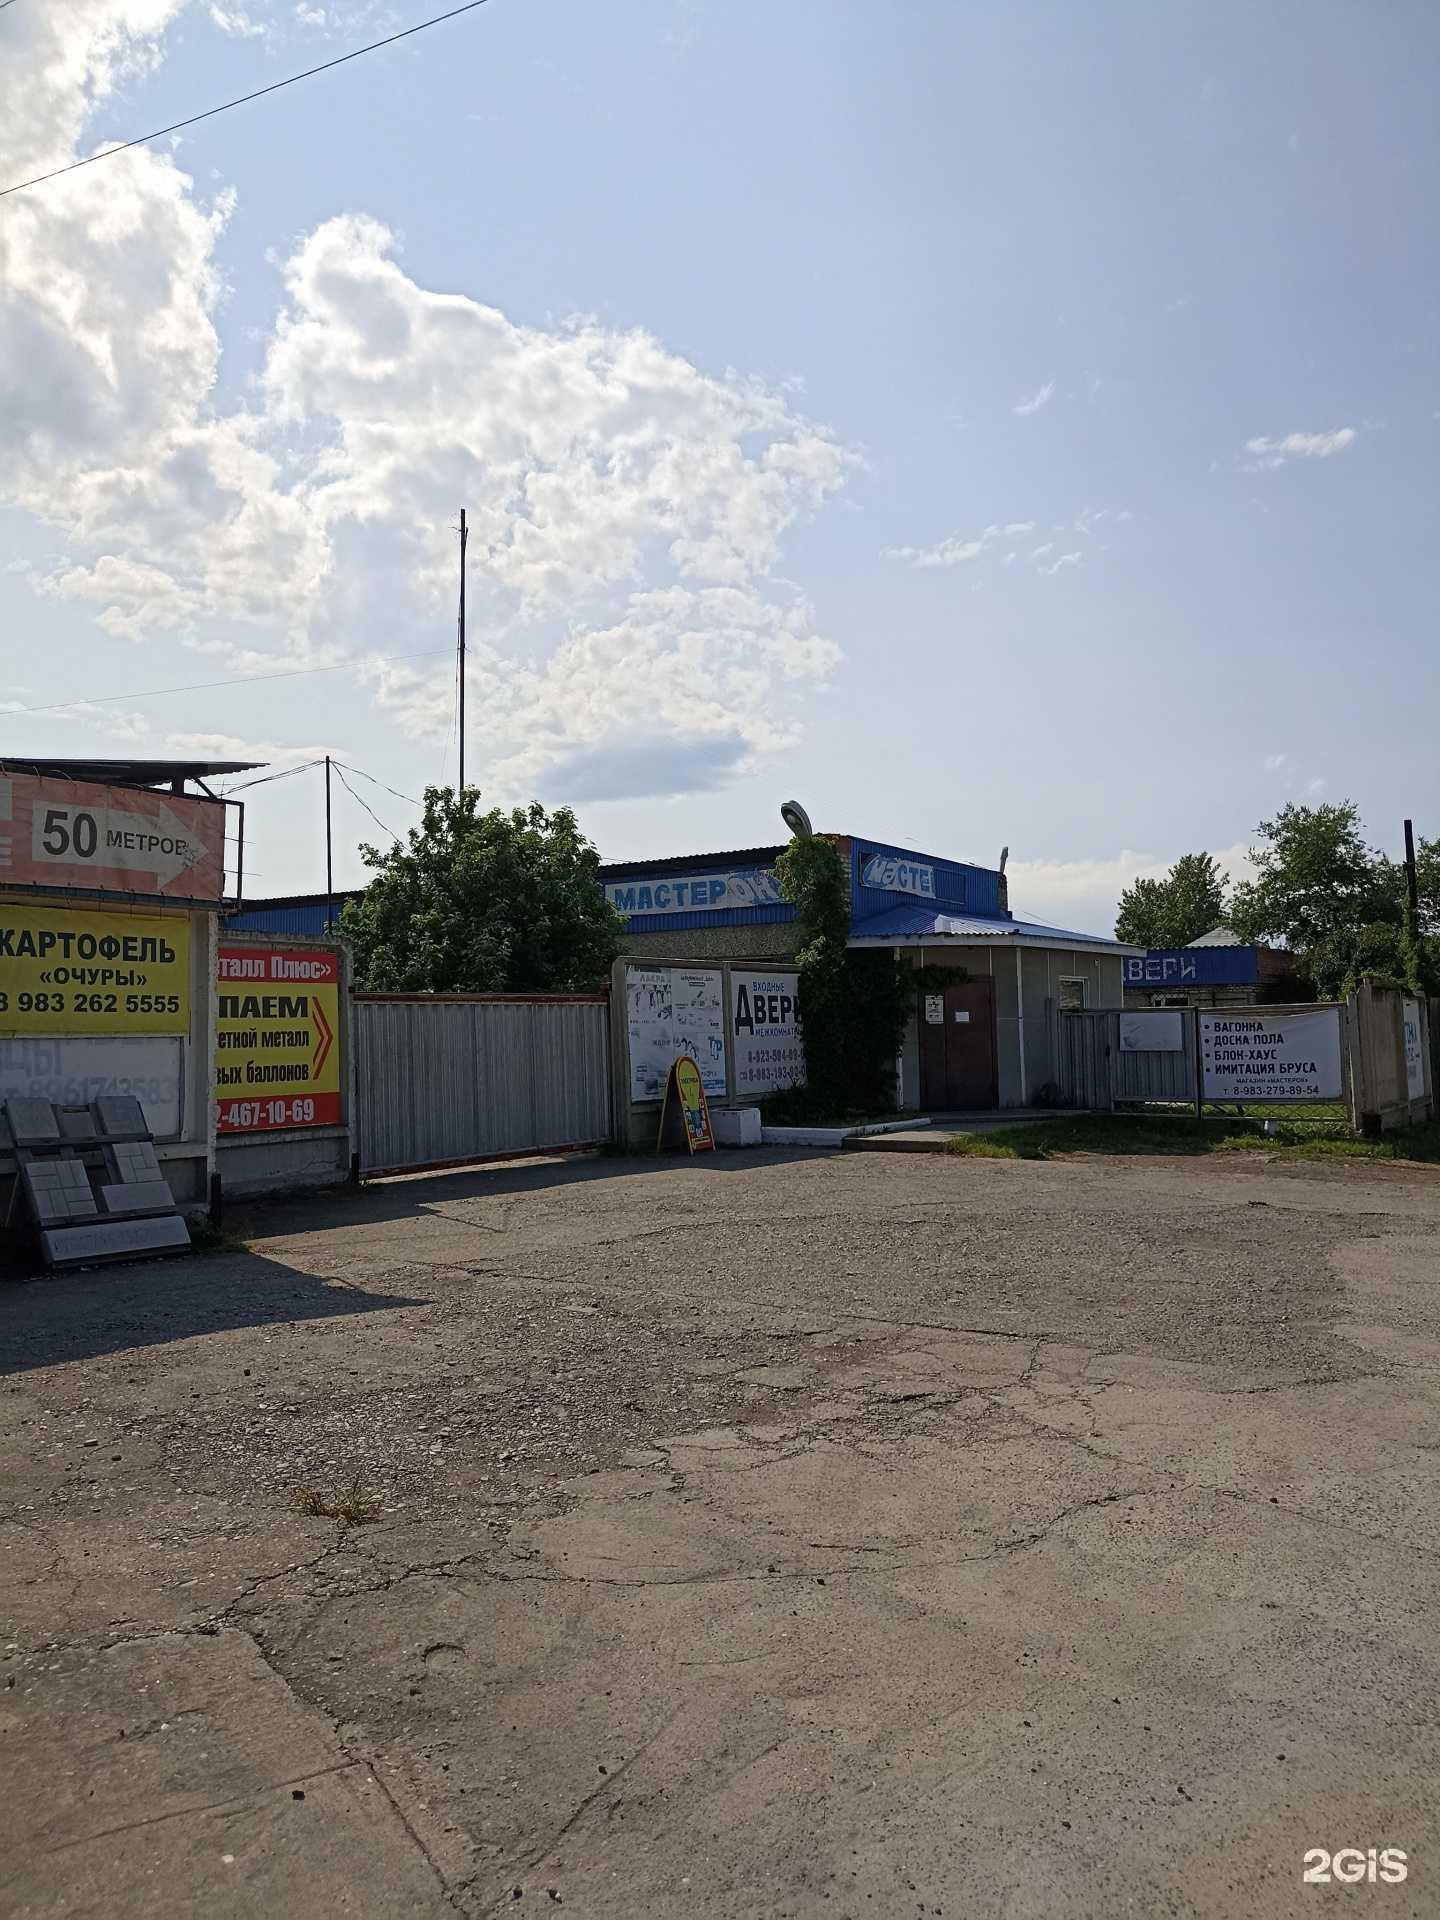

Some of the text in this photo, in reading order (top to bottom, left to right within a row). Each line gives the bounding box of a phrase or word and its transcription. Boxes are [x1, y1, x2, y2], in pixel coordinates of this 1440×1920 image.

[42, 809, 98, 858] 50
[106, 830, 188, 856] МЕТРОВ
[0, 929, 176, 963] КАРТОФЕЛЬ
[40, 967, 147, 986] «ОЧУРЫ»
[218, 957, 265, 978] талл
[1124, 956, 1197, 982] ВЕРИ
[752, 981, 785, 992] ВХОДНЫЕ
[18, 993, 65, 1013] 983
[73, 994, 118, 1013] 262
[126, 995, 180, 1014] 5555
[261, 1031, 310, 1048] металл
[1214, 1034, 1284, 1046] ДОСКА ПОЛА
[1214, 1049, 1277, 1060] БЛОК-ХАУС
[247, 1060, 309, 1083] баллонов
[1215, 1062, 1317, 1075] ИМИТАЦИЯ БРУСА
[1233, 1085, 1320, 1095] 8-983-279-89-54
